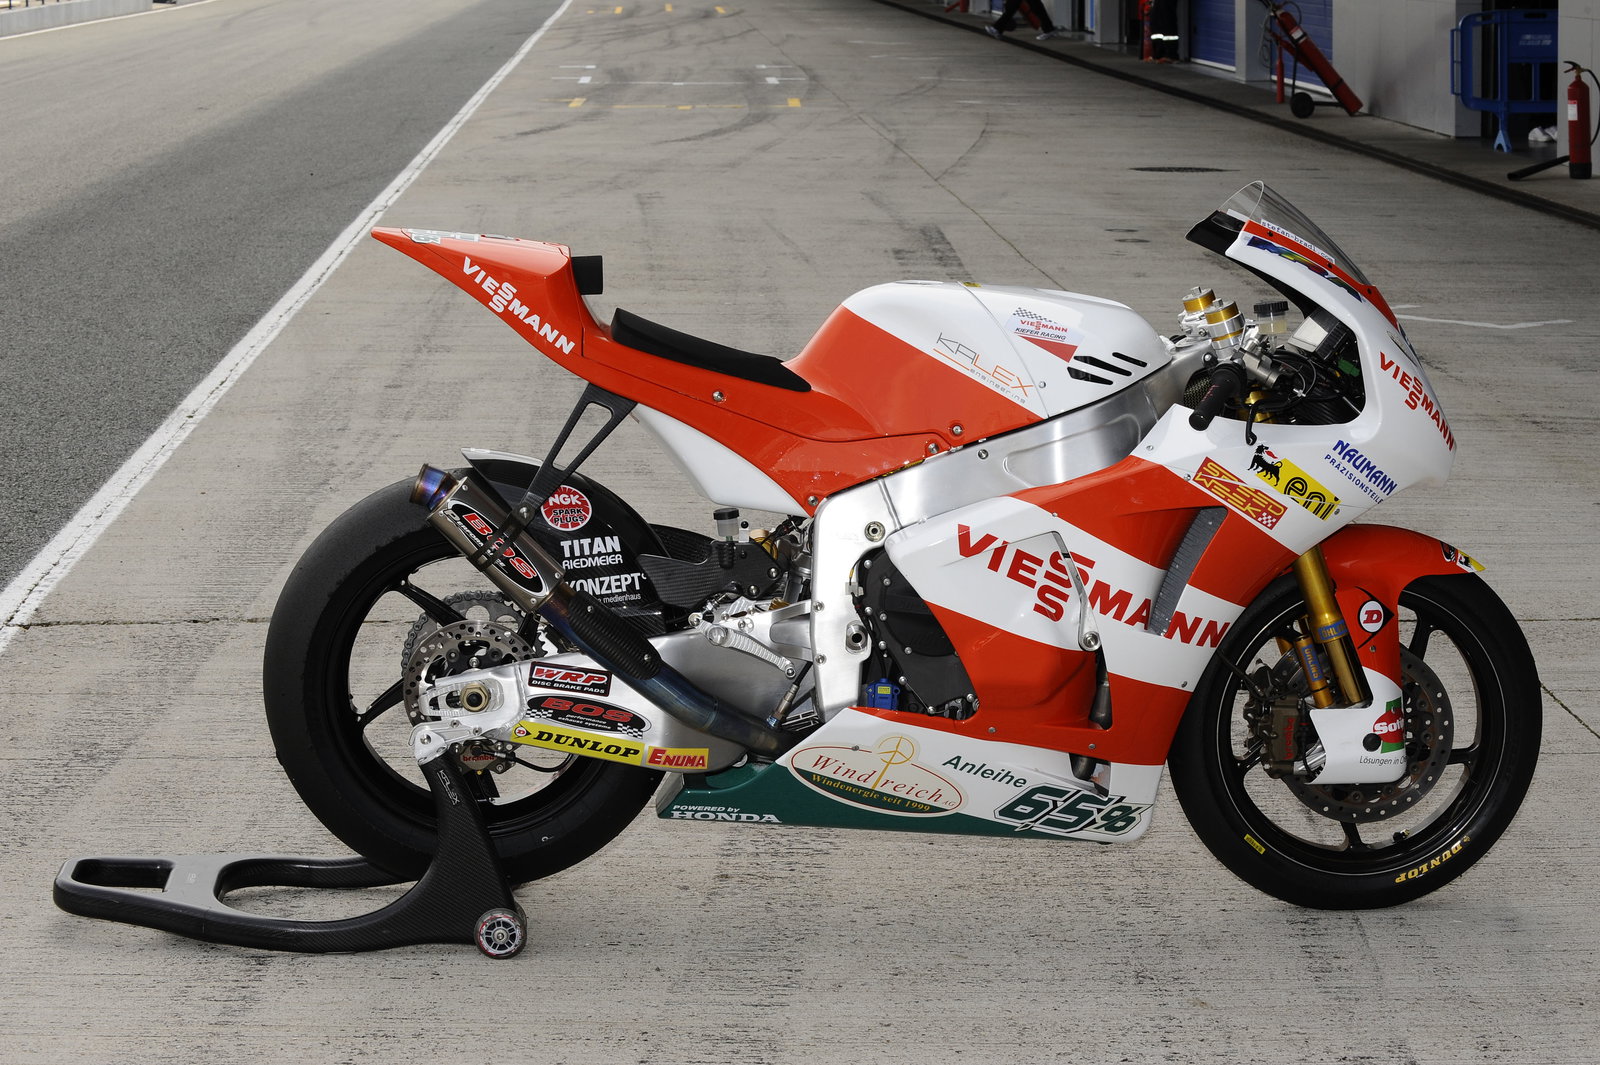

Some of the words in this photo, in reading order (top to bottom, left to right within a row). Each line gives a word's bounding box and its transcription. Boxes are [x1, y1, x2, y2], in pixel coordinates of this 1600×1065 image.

[463, 256, 575, 354] VIESSMANN
[1015, 327, 1040, 335] KIEFER
[1040, 331, 1066, 340] RACING
[1020, 320, 1068, 333] VIESSMANN
[937, 332, 1033, 397] KALEX
[1380, 351, 1454, 452] VIESSMANN
[1332, 439, 1397, 496] NAUMANN
[548, 494, 582, 506] NGK
[1284, 477, 1339, 520] eni
[553, 508, 583, 516] SPARK
[554, 515, 585, 524] PLUGS
[560, 535, 621, 558] TITAN
[562, 554, 623, 570] RIEDMEIER
[958, 523, 1231, 648] VIESSMANN
[533, 666, 607, 684] WRP
[553, 682, 582, 691] BRAKE
[583, 686, 605, 694] PADS
[541, 697, 634, 723] BOS
[533, 730, 640, 757] DUNLOP
[648, 748, 706, 767] ENUMA
[942, 755, 1027, 788] Anleihe
[811, 774, 880, 799] Windenergie
[883, 795, 902, 805] seit
[905, 800, 931, 812] 1999
[671, 810, 782, 823] HONDA
[1395, 840, 1463, 884] DUNLOP
